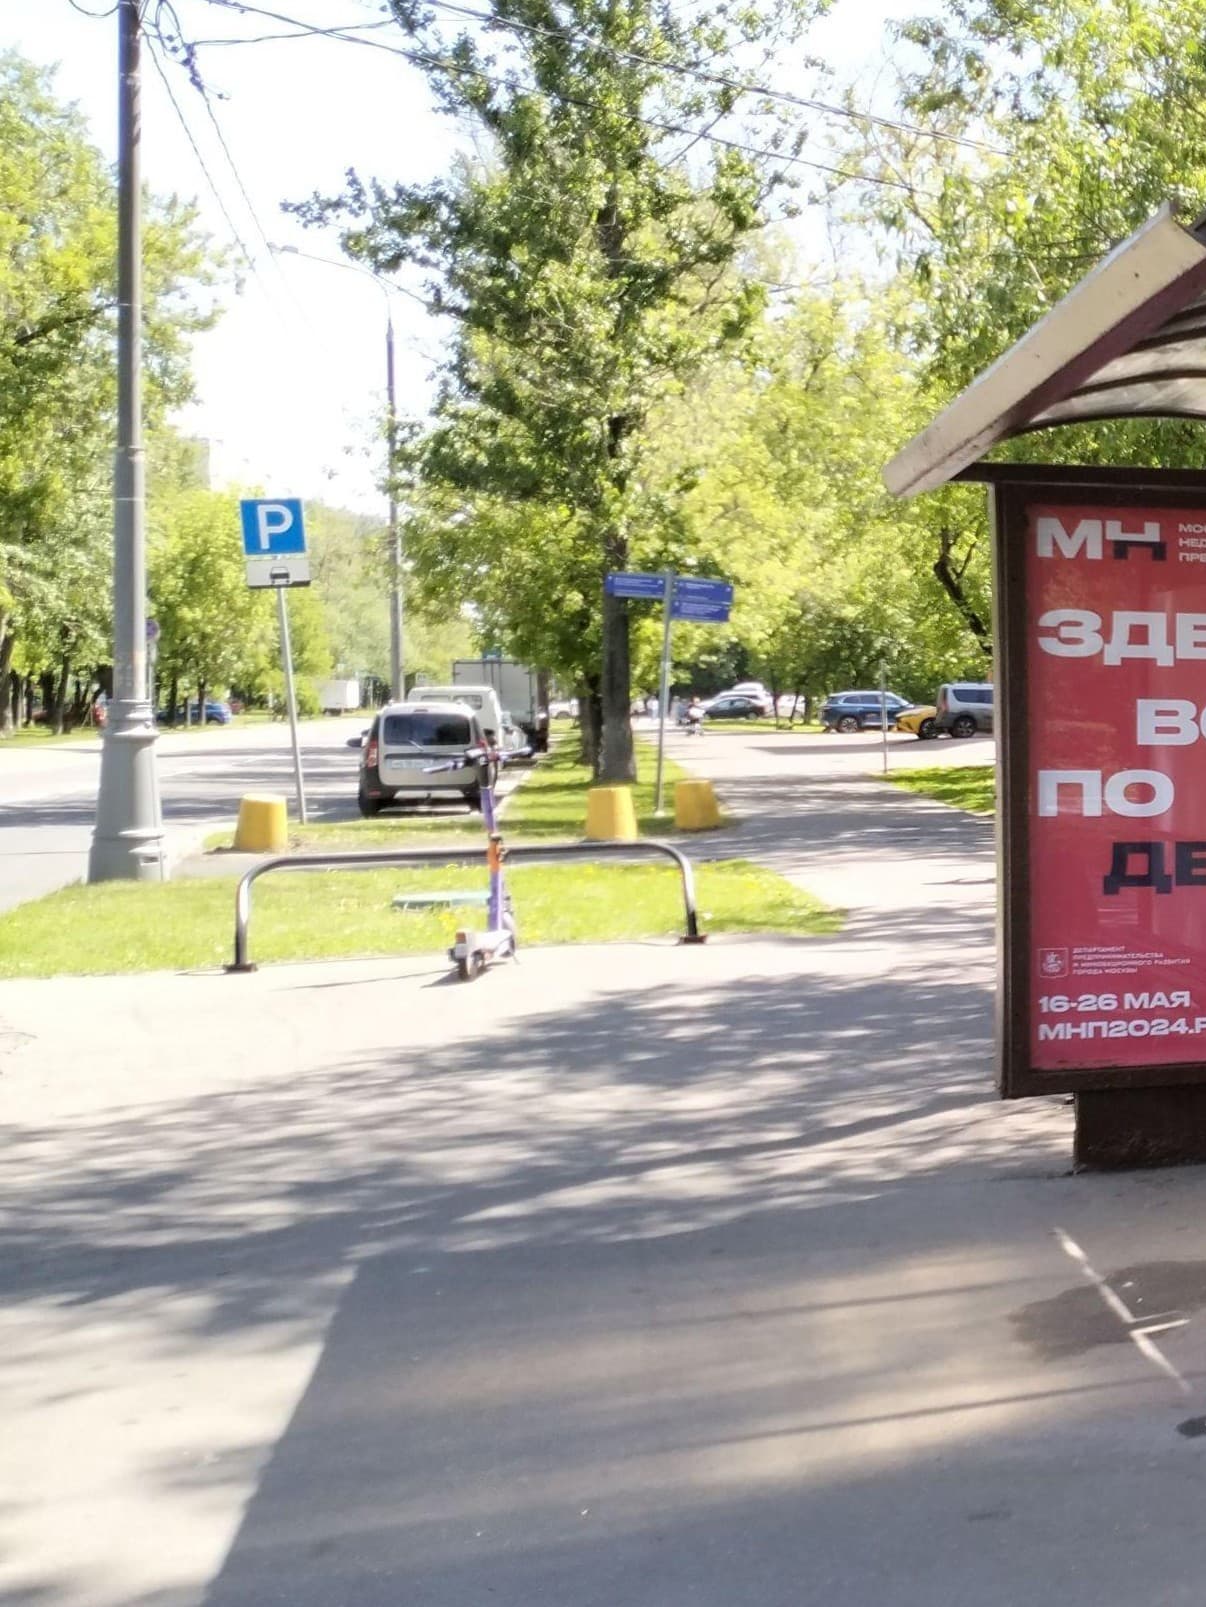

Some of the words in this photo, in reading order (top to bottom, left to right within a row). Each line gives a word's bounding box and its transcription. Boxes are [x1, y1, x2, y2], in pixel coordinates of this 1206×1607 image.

[257, 504, 293, 550] P
[1037, 769, 1175, 818] ПО
[1039, 993, 1118, 1013] 16-26
[1123, 990, 1191, 1010] МАЯ
